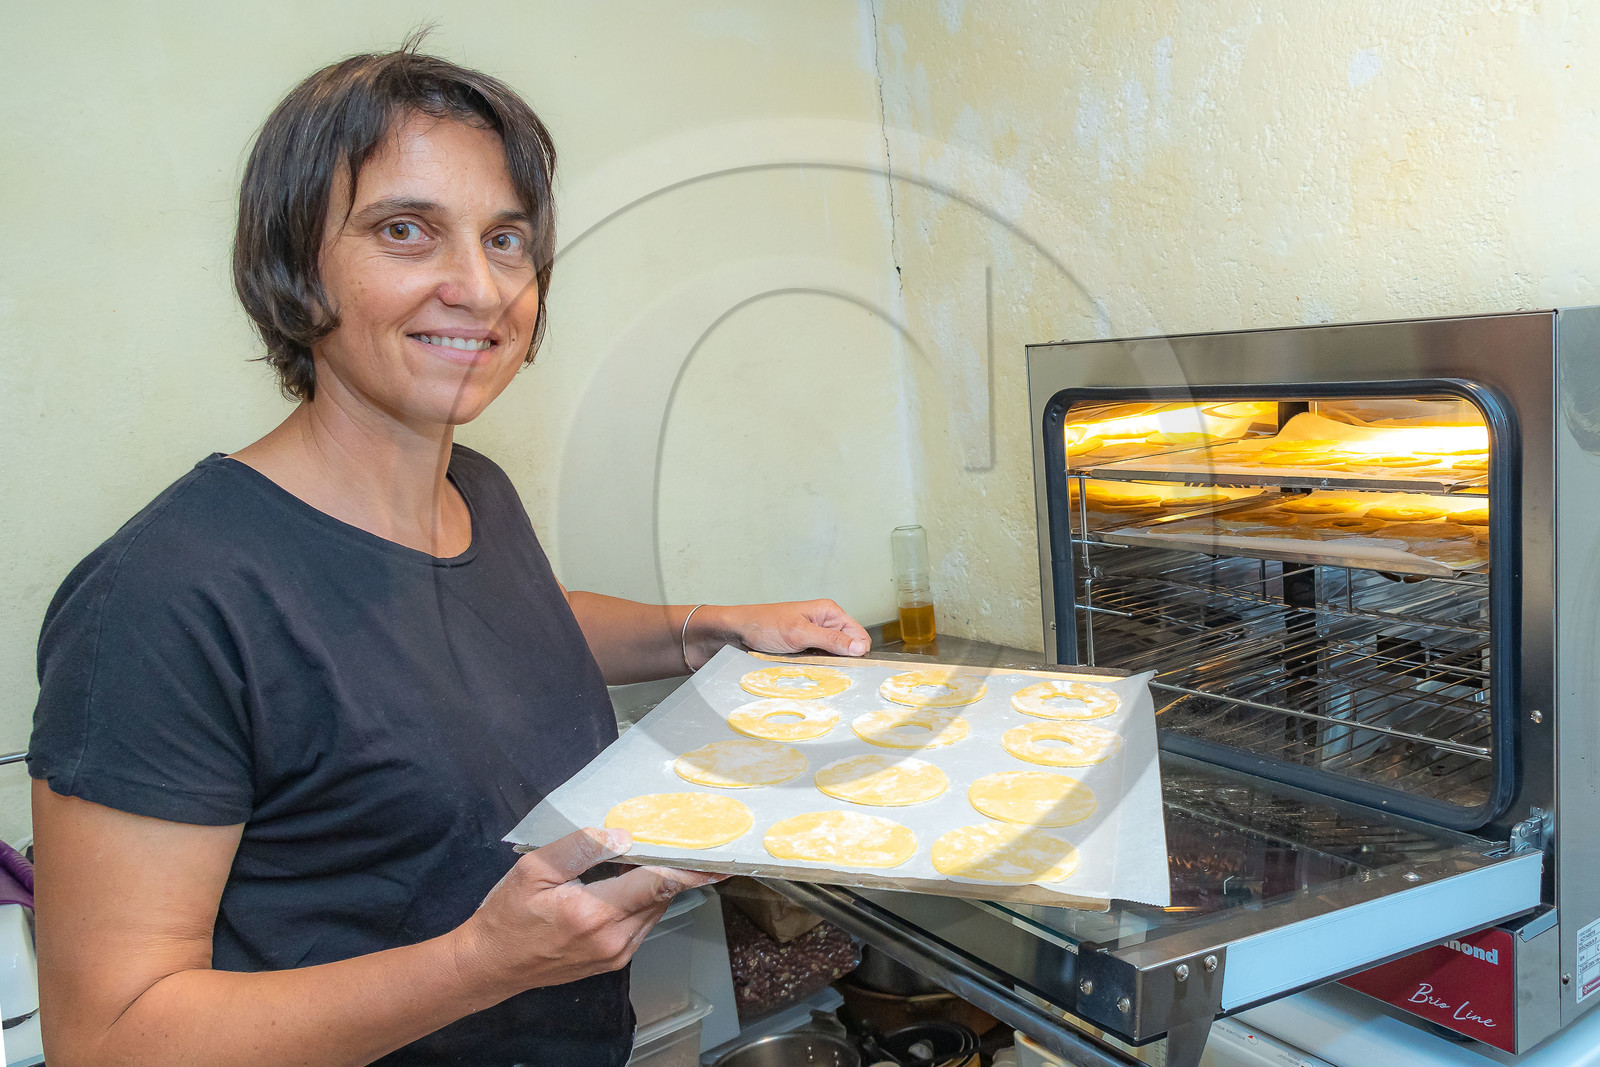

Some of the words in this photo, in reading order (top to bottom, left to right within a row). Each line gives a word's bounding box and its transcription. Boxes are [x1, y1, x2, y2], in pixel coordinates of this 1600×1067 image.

[1441, 940, 1498, 965] mond
[1408, 983, 1450, 1008] Brio
[1453, 1001, 1496, 1027] Line
